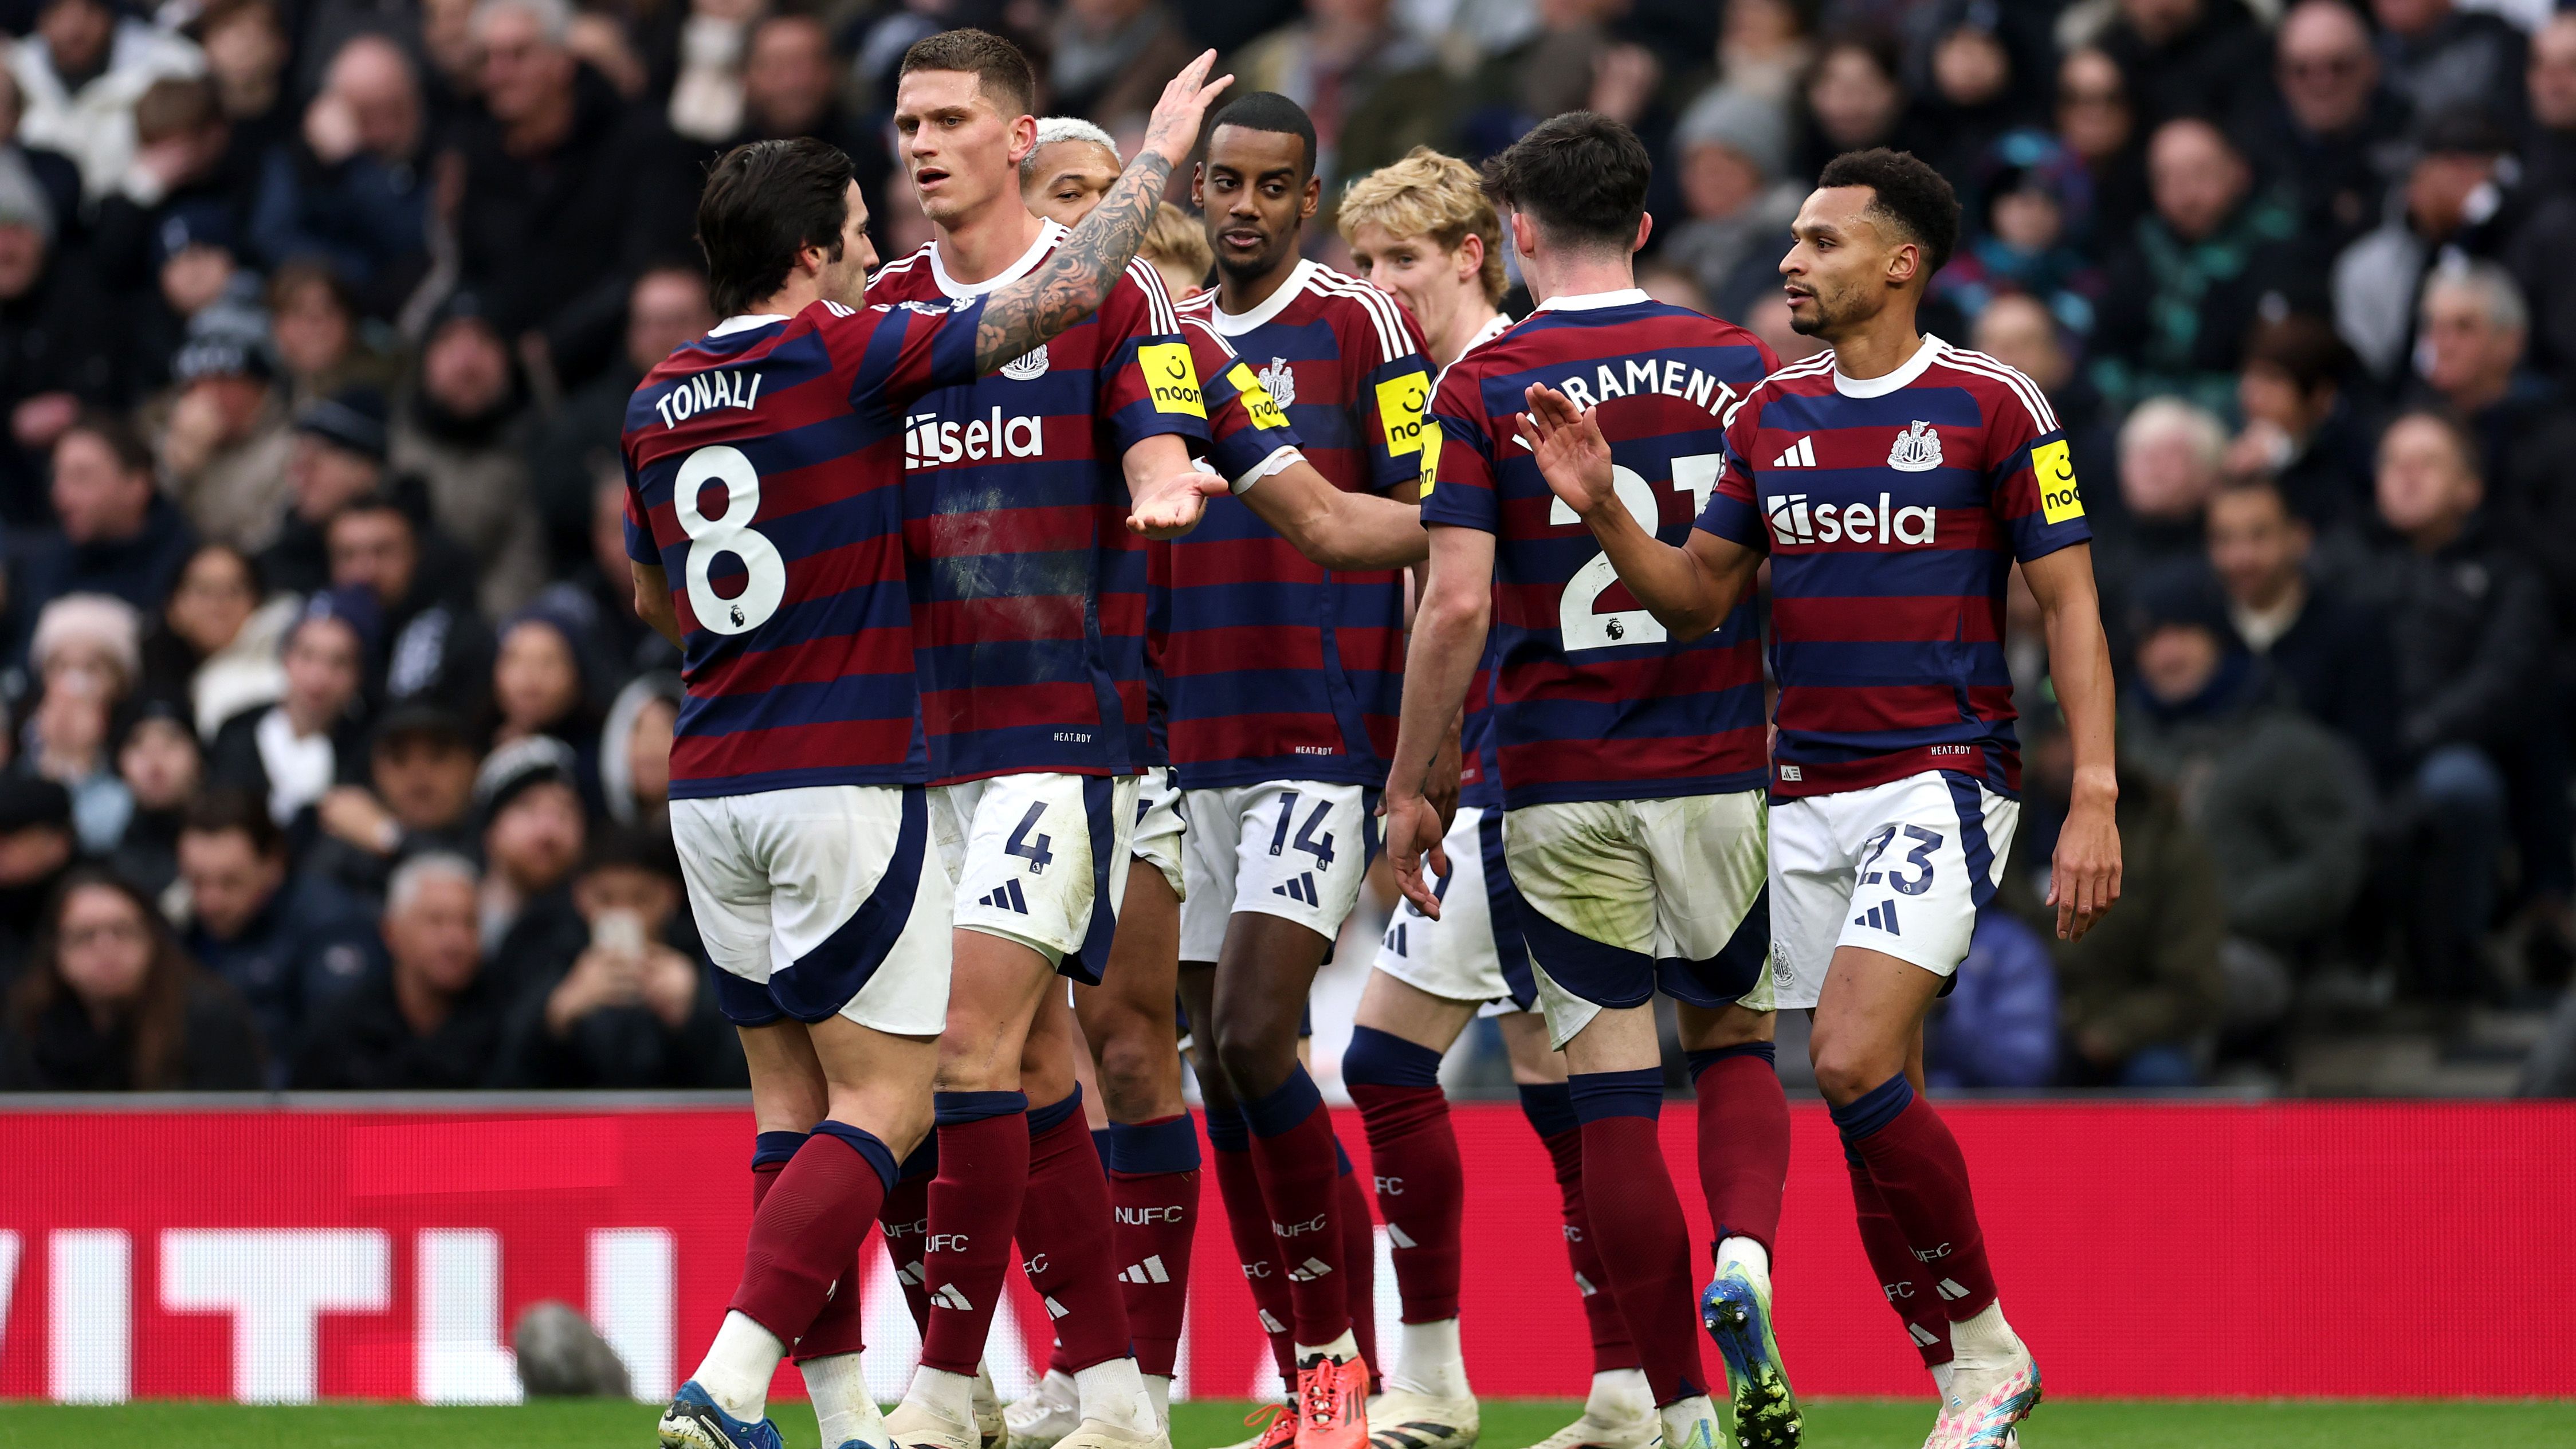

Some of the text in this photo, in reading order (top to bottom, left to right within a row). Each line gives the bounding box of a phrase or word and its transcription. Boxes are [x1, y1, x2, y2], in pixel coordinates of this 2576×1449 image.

[656, 370, 762, 430] TONALI
[1155, 386, 1202, 406] noon
[1252, 400, 1282, 418] noo
[939, 406, 1043, 463] sela
[1391, 422, 1420, 442] no
[2045, 486, 2081, 509] noo
[1815, 492, 1935, 544] sela
[674, 445, 786, 635] 8
[1054, 732, 1091, 743] HEAT.RDY
[1295, 746, 1333, 755] HEAT.RDY
[1931, 745, 1970, 755] HEAT.RDY
[1004, 801, 1053, 874] 4
[1269, 792, 1334, 872] 14
[1858, 823, 1943, 896] 23
[1373, 1176, 1404, 1195] FC
[1115, 1205, 1183, 1225] NUFC
[878, 1218, 927, 1238] UFC
[926, 1234, 968, 1252] UFC
[1909, 1242, 1951, 1263] UFC
[1023, 1253, 1049, 1278] FC
[1242, 1261, 1271, 1279] FC
[0, 1227, 679, 1405] ITH
